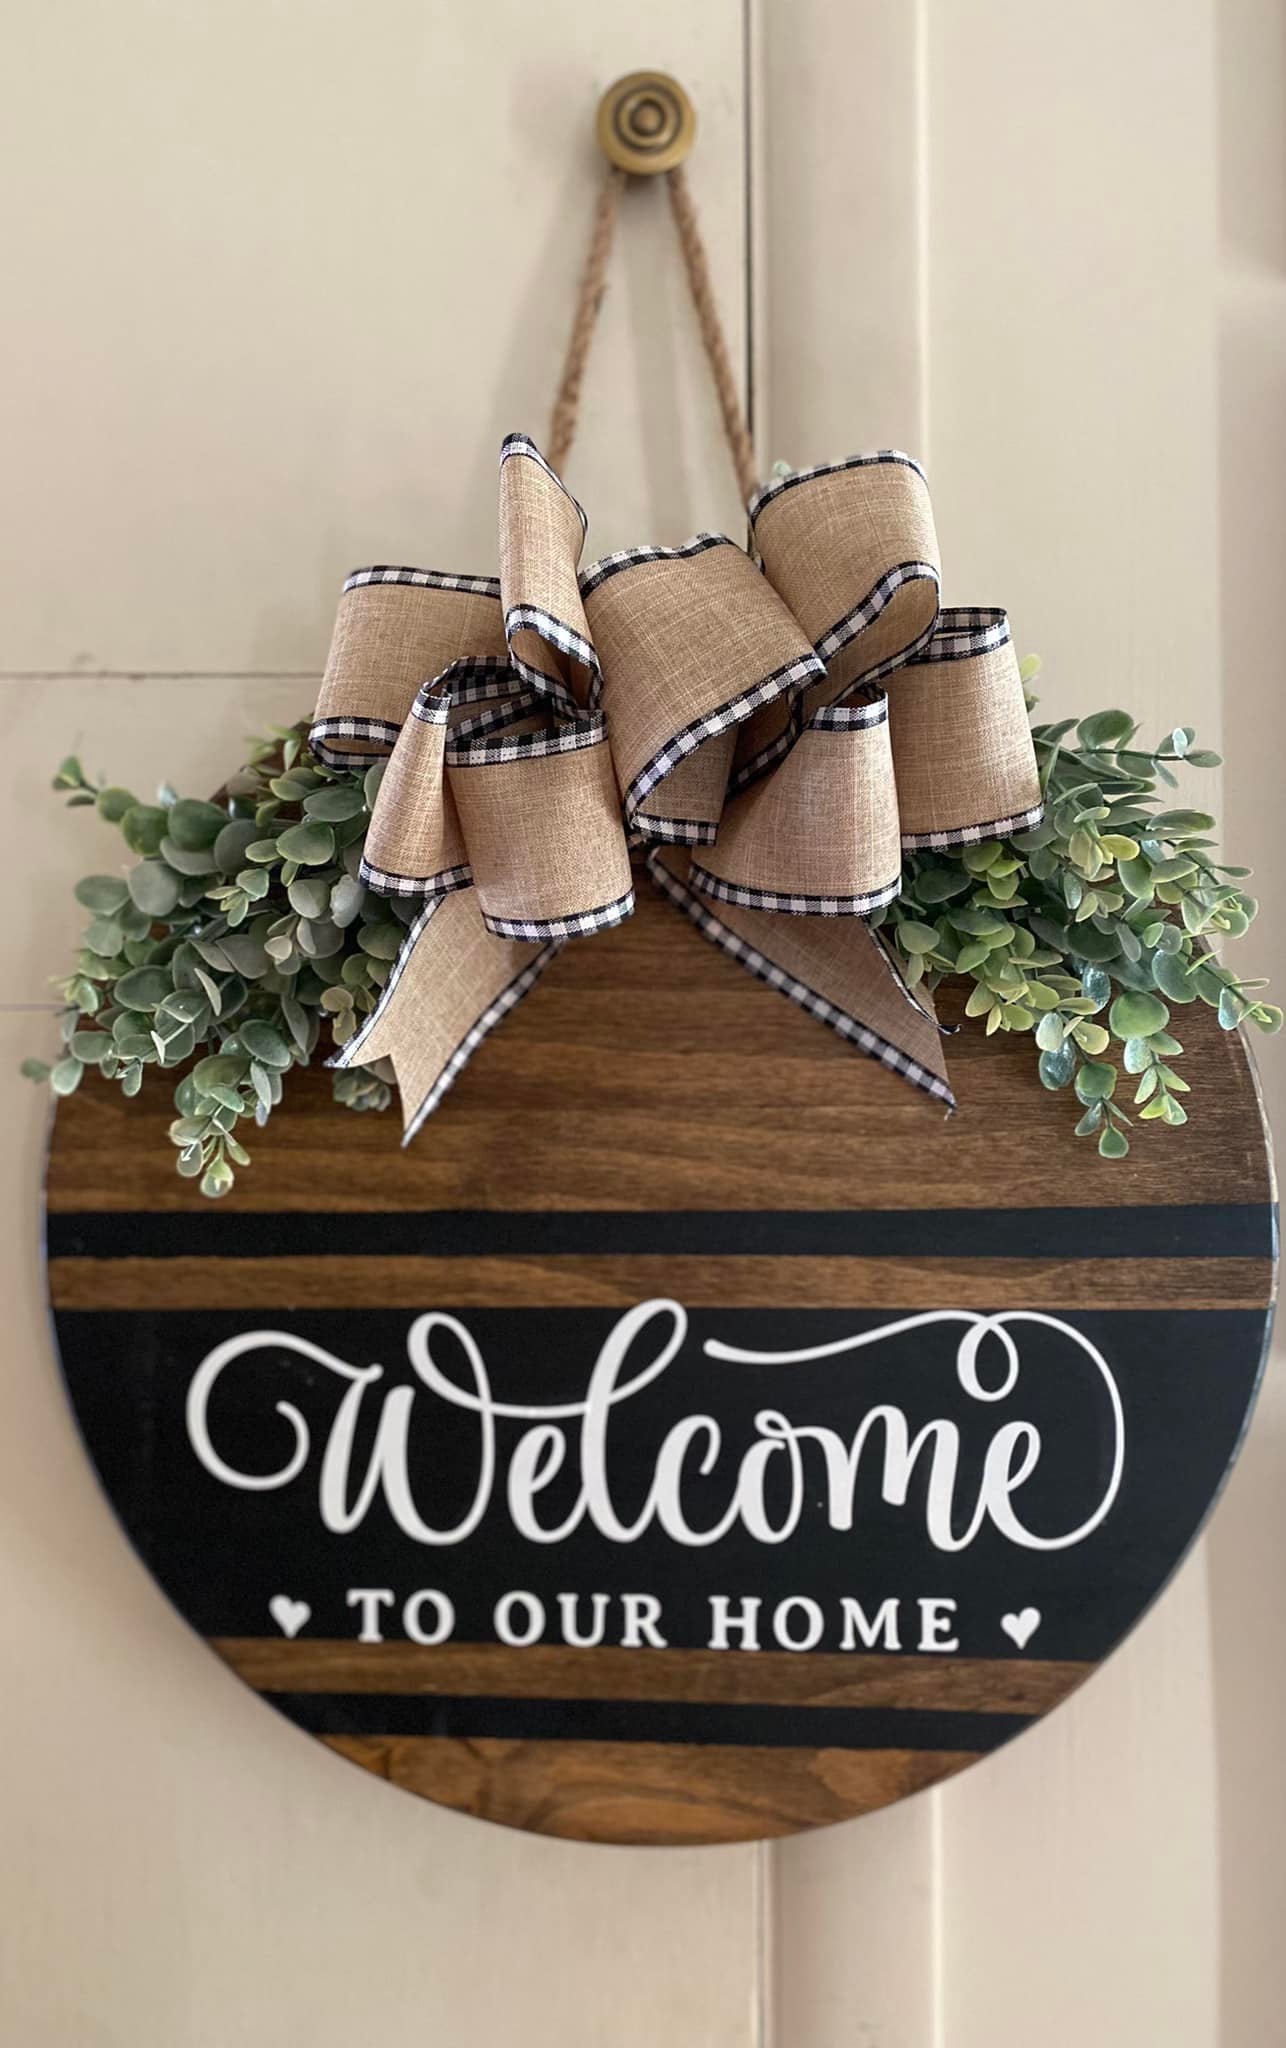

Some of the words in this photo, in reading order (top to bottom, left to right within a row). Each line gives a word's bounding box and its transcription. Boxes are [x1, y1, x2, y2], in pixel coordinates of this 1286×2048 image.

[187, 1299, 1125, 1552] Welcome
[347, 1589, 454, 1645] TO
[494, 1591, 668, 1648] OUR
[708, 1595, 960, 1652] HOME
